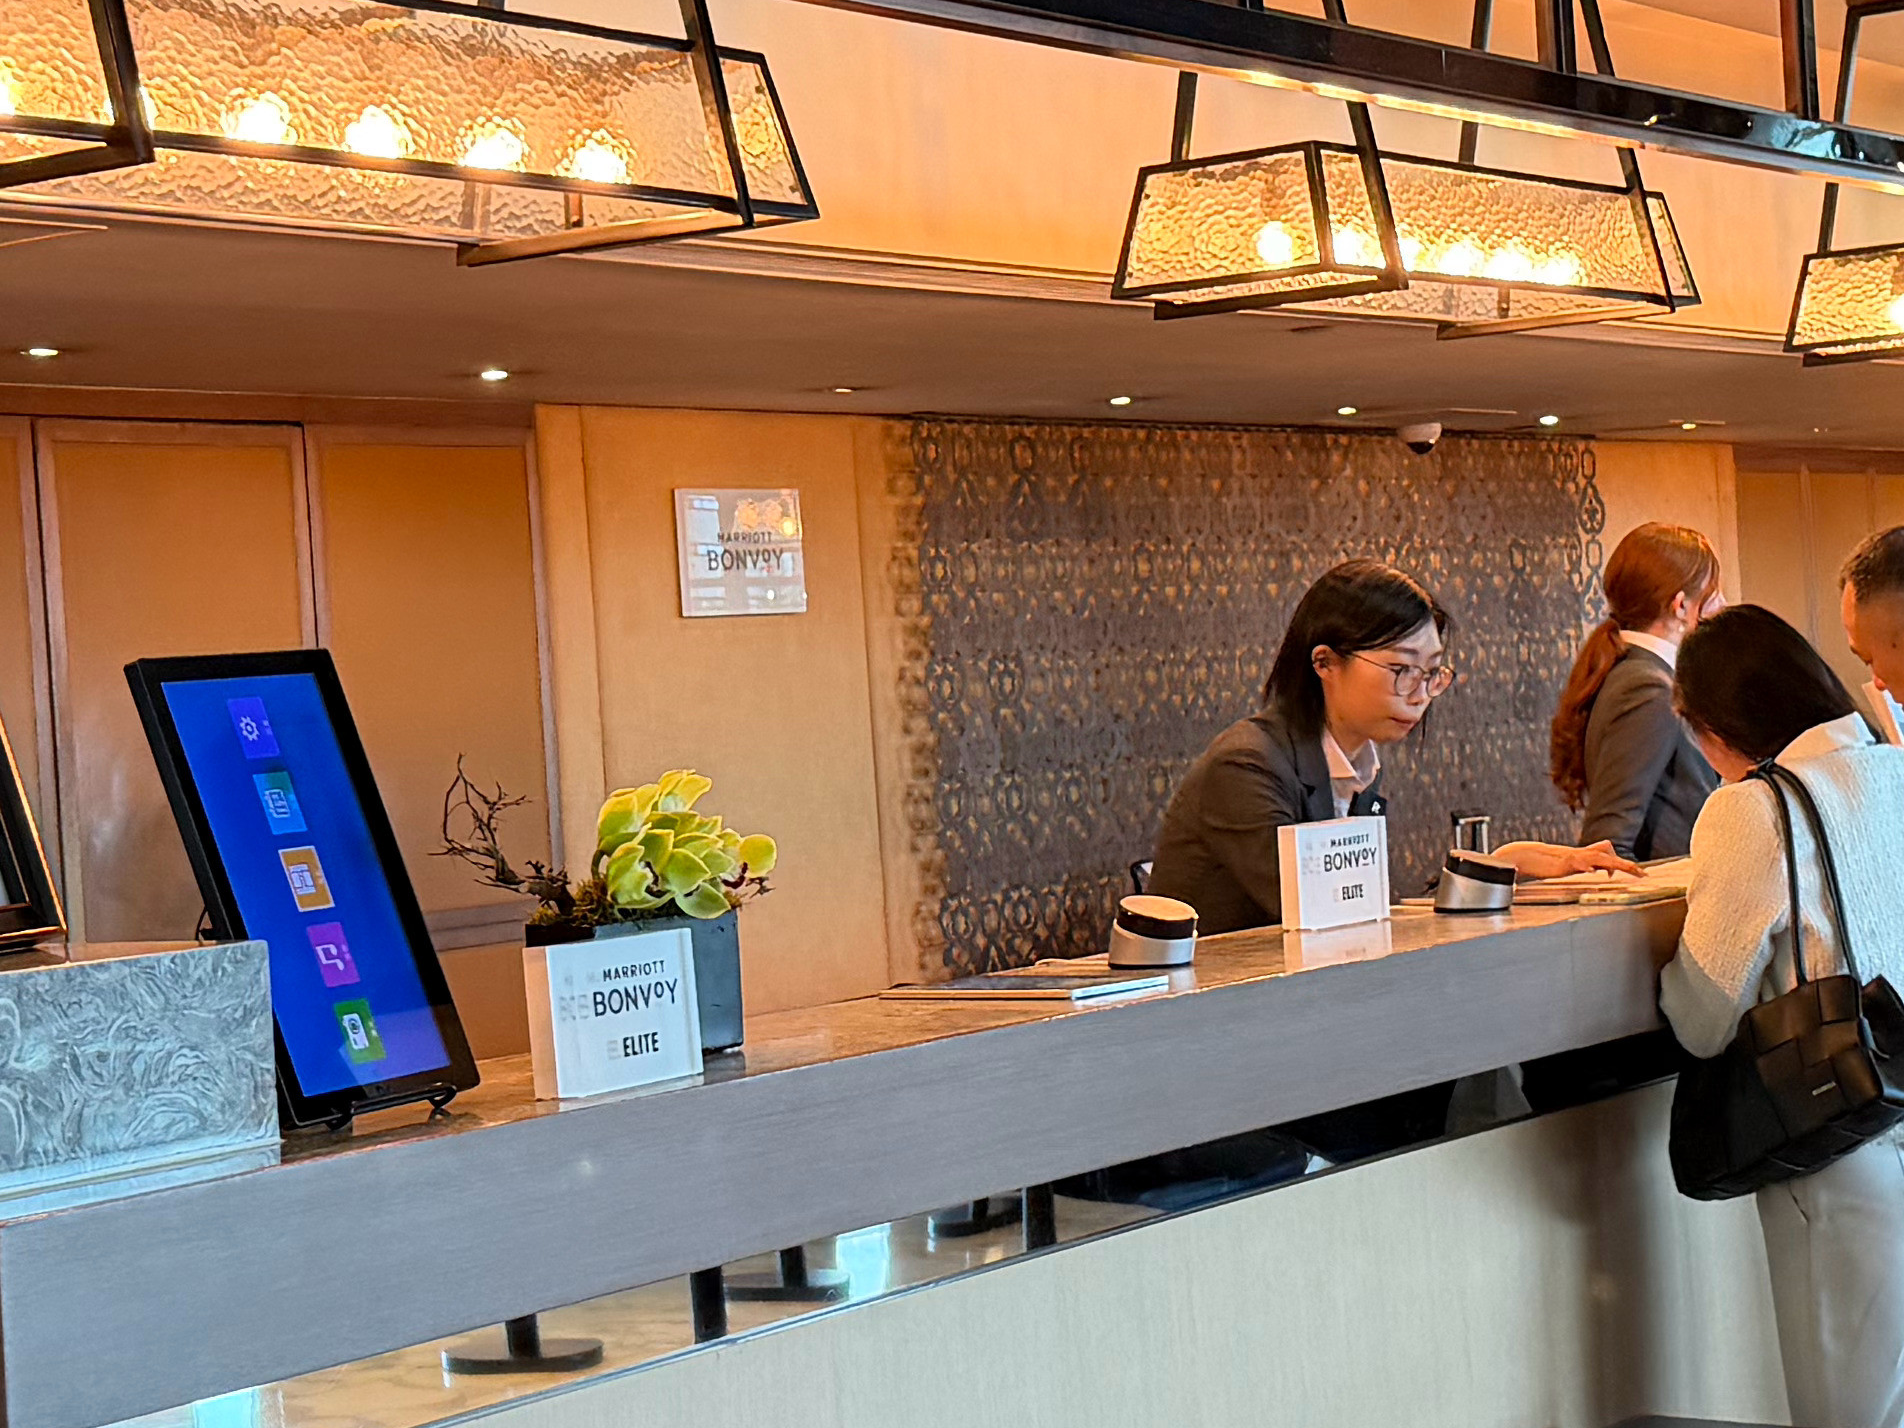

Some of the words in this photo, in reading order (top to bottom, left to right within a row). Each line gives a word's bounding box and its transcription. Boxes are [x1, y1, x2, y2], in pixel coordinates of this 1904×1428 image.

[717, 531, 773, 544] MARRIOTT
[706, 548, 784, 571] BONVOY
[1330, 833, 1370, 848] MARRIOTT
[1323, 847, 1377, 872] BONVOY
[1341, 883, 1364, 901] ELITE
[602, 959, 665, 982] MARRIOTT
[592, 978, 678, 1017] BONVOY
[622, 1031, 659, 1058] ELITE
